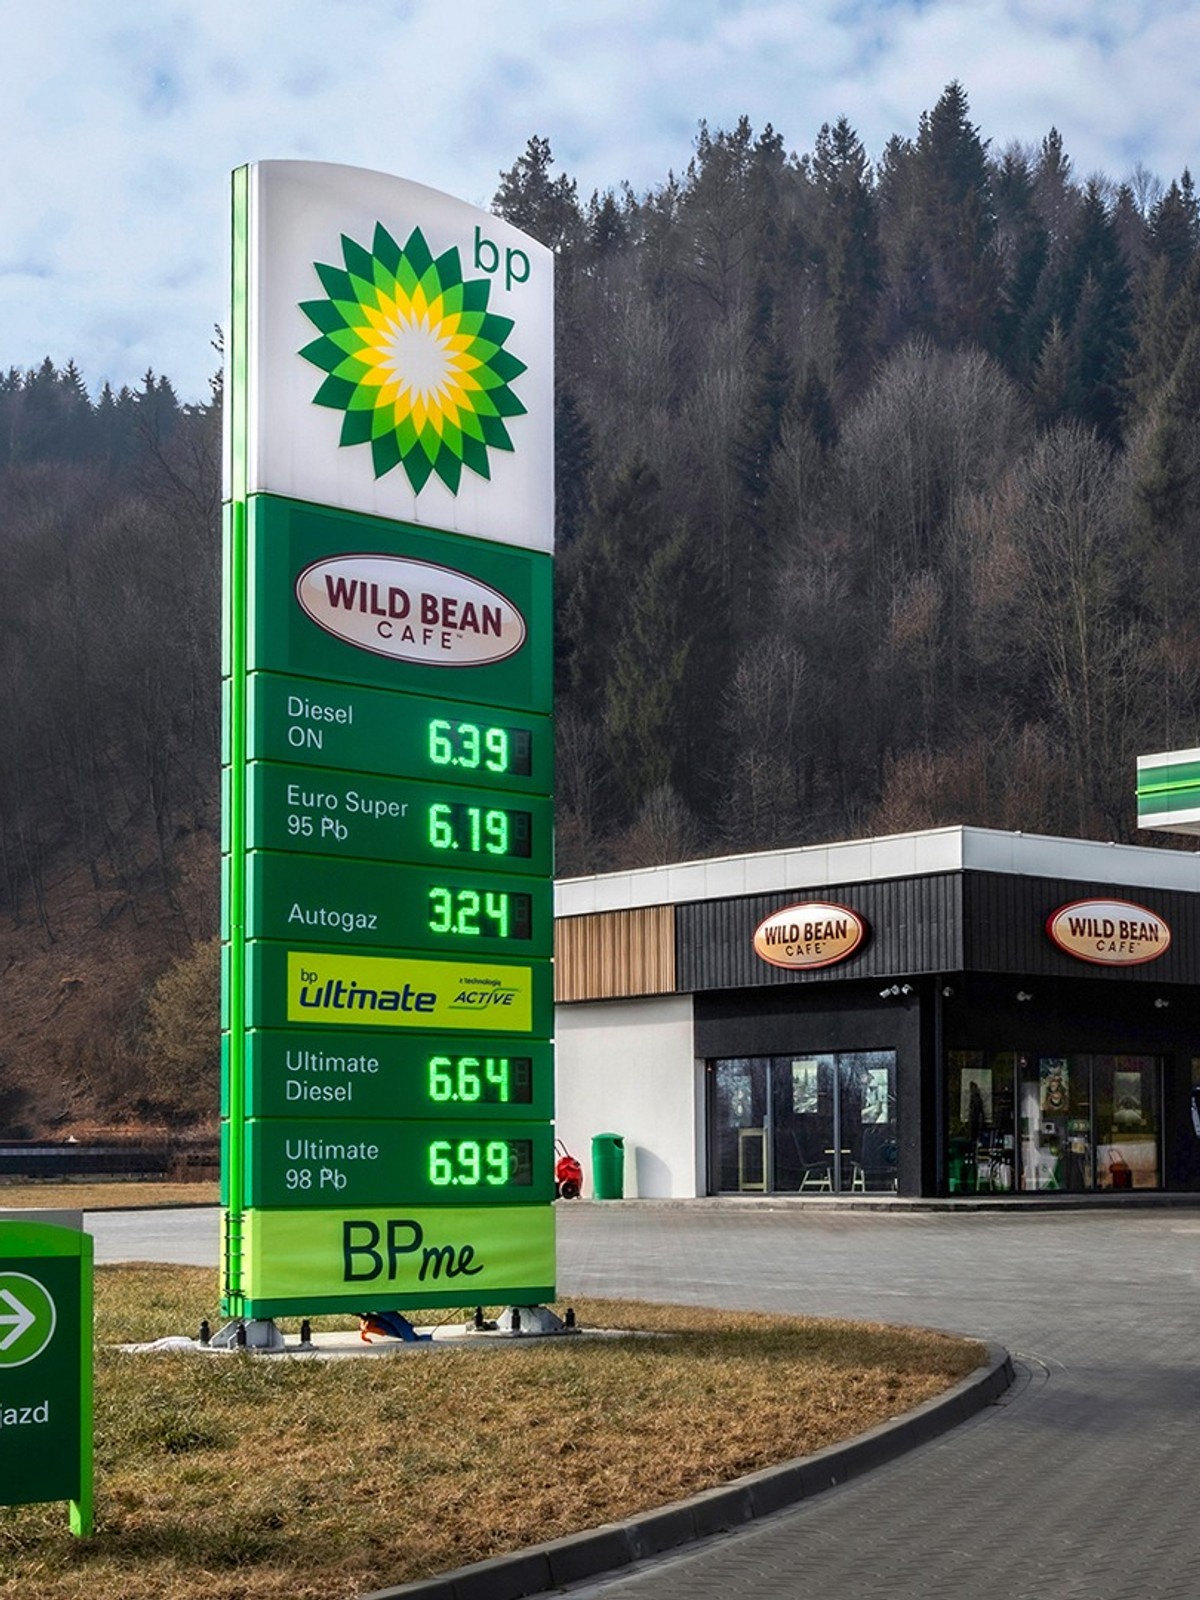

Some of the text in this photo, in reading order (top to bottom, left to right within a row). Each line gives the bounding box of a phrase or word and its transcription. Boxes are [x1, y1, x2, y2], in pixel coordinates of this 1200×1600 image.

[473, 225, 530, 291] bp
[325, 575, 502, 637] WILD BEAN
[287, 696, 353, 724] Diesel
[288, 726, 323, 749] ON
[429, 719, 508, 773] 6.39
[287, 784, 408, 819] Euro Super
[287, 814, 348, 841] 95 Pb
[429, 803, 508, 855] 6.19
[287, 903, 378, 932] Autogaz
[429, 887, 508, 938] 3.24
[765, 920, 847, 945] WILD BEAN
[1068, 918, 1158, 942] WILD BEAN
[300, 968, 318, 984] bp
[299, 979, 437, 1013] ultimate
[453, 991, 515, 1005] ACTIVE
[286, 1050, 379, 1073] Ultimate
[286, 1080, 352, 1101] Diesel
[429, 1056, 508, 1102] 6.64
[286, 1139, 379, 1160] Ultimate
[429, 1141, 508, 1186] 6.99
[285, 1167, 347, 1190] 98 Pb
